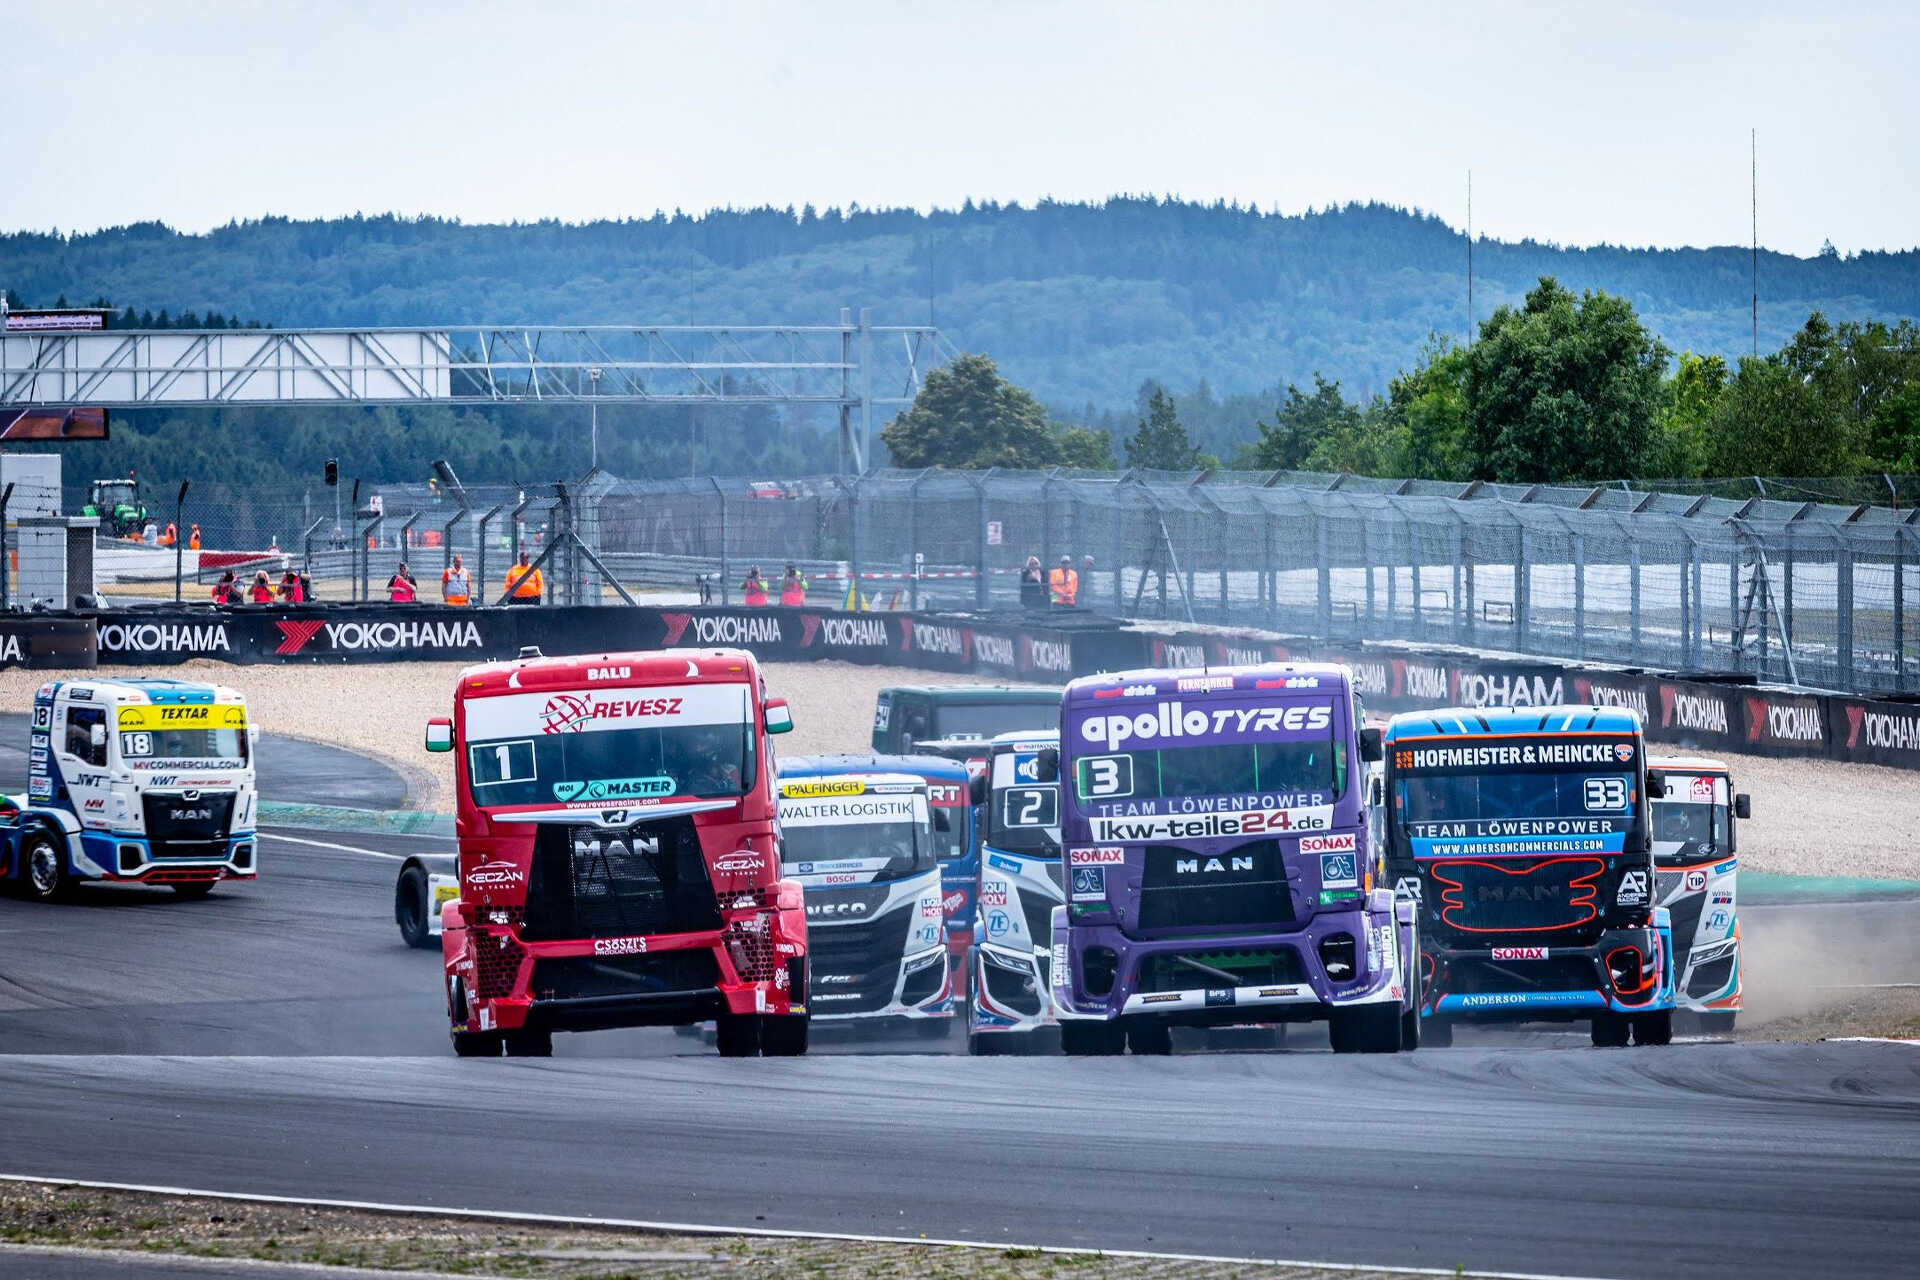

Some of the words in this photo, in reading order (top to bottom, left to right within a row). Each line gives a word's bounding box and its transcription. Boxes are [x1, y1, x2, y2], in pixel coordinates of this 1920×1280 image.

[97, 624, 229, 651] YOKOHAMA
[325, 621, 482, 649] YOKOHAMA
[693, 617, 781, 642] YOKOHAMA
[821, 619, 888, 646] YOKOHAMA
[587, 667, 631, 681] BALU
[34, 708, 48, 726] 18
[161, 708, 208, 719] TEXTAR
[592, 698, 683, 719] REVESZ
[1674, 694, 1728, 734] YOKOHAMA
[1081, 702, 1209, 751] apollo
[1211, 706, 1332, 735] TYRES
[1768, 706, 1822, 741] YOKOHAMA
[1864, 711, 1920, 750] YOKOHAM
[124, 734, 149, 754] 18
[495, 745, 512, 781] 1
[1414, 746, 1521, 767] HOFMEISTER
[1523, 745, 1536, 763] &
[1539, 744, 1613, 763] MEINCKE
[150, 775, 178, 786] NWT
[1092, 759, 1119, 794] 3
[607, 780, 671, 795] MASTER
[788, 782, 859, 796] PALFINGER
[1587, 780, 1624, 809] 33
[171, 809, 212, 820] MAN
[779, 804, 839, 819] WALTER
[843, 802, 913, 817] LOGISTIK
[1020, 791, 1042, 824] 2
[1099, 801, 1156, 818] TEAM
[1168, 793, 1323, 815] LÖWENPOWER
[1100, 810, 1324, 841] lkw-teile24.de
[1416, 824, 1466, 838] TEAM
[1477, 820, 1612, 836] LÖWENPOWER
[574, 837, 659, 857] MAN
[1301, 836, 1354, 851] SONAX
[1432, 840, 1603, 854] WWW.ANDERSONCOMMERCIALS.COM
[1071, 850, 1122, 863] SONAX
[1176, 856, 1253, 874] MAN
[826, 875, 856, 884] BOSCH
[1395, 877, 1422, 899] AR
[1617, 871, 1648, 893] AR
[1689, 876, 1704, 887] TIP
[1493, 948, 1544, 960] SONAX
[1462, 994, 1526, 1007] ANDERSON
